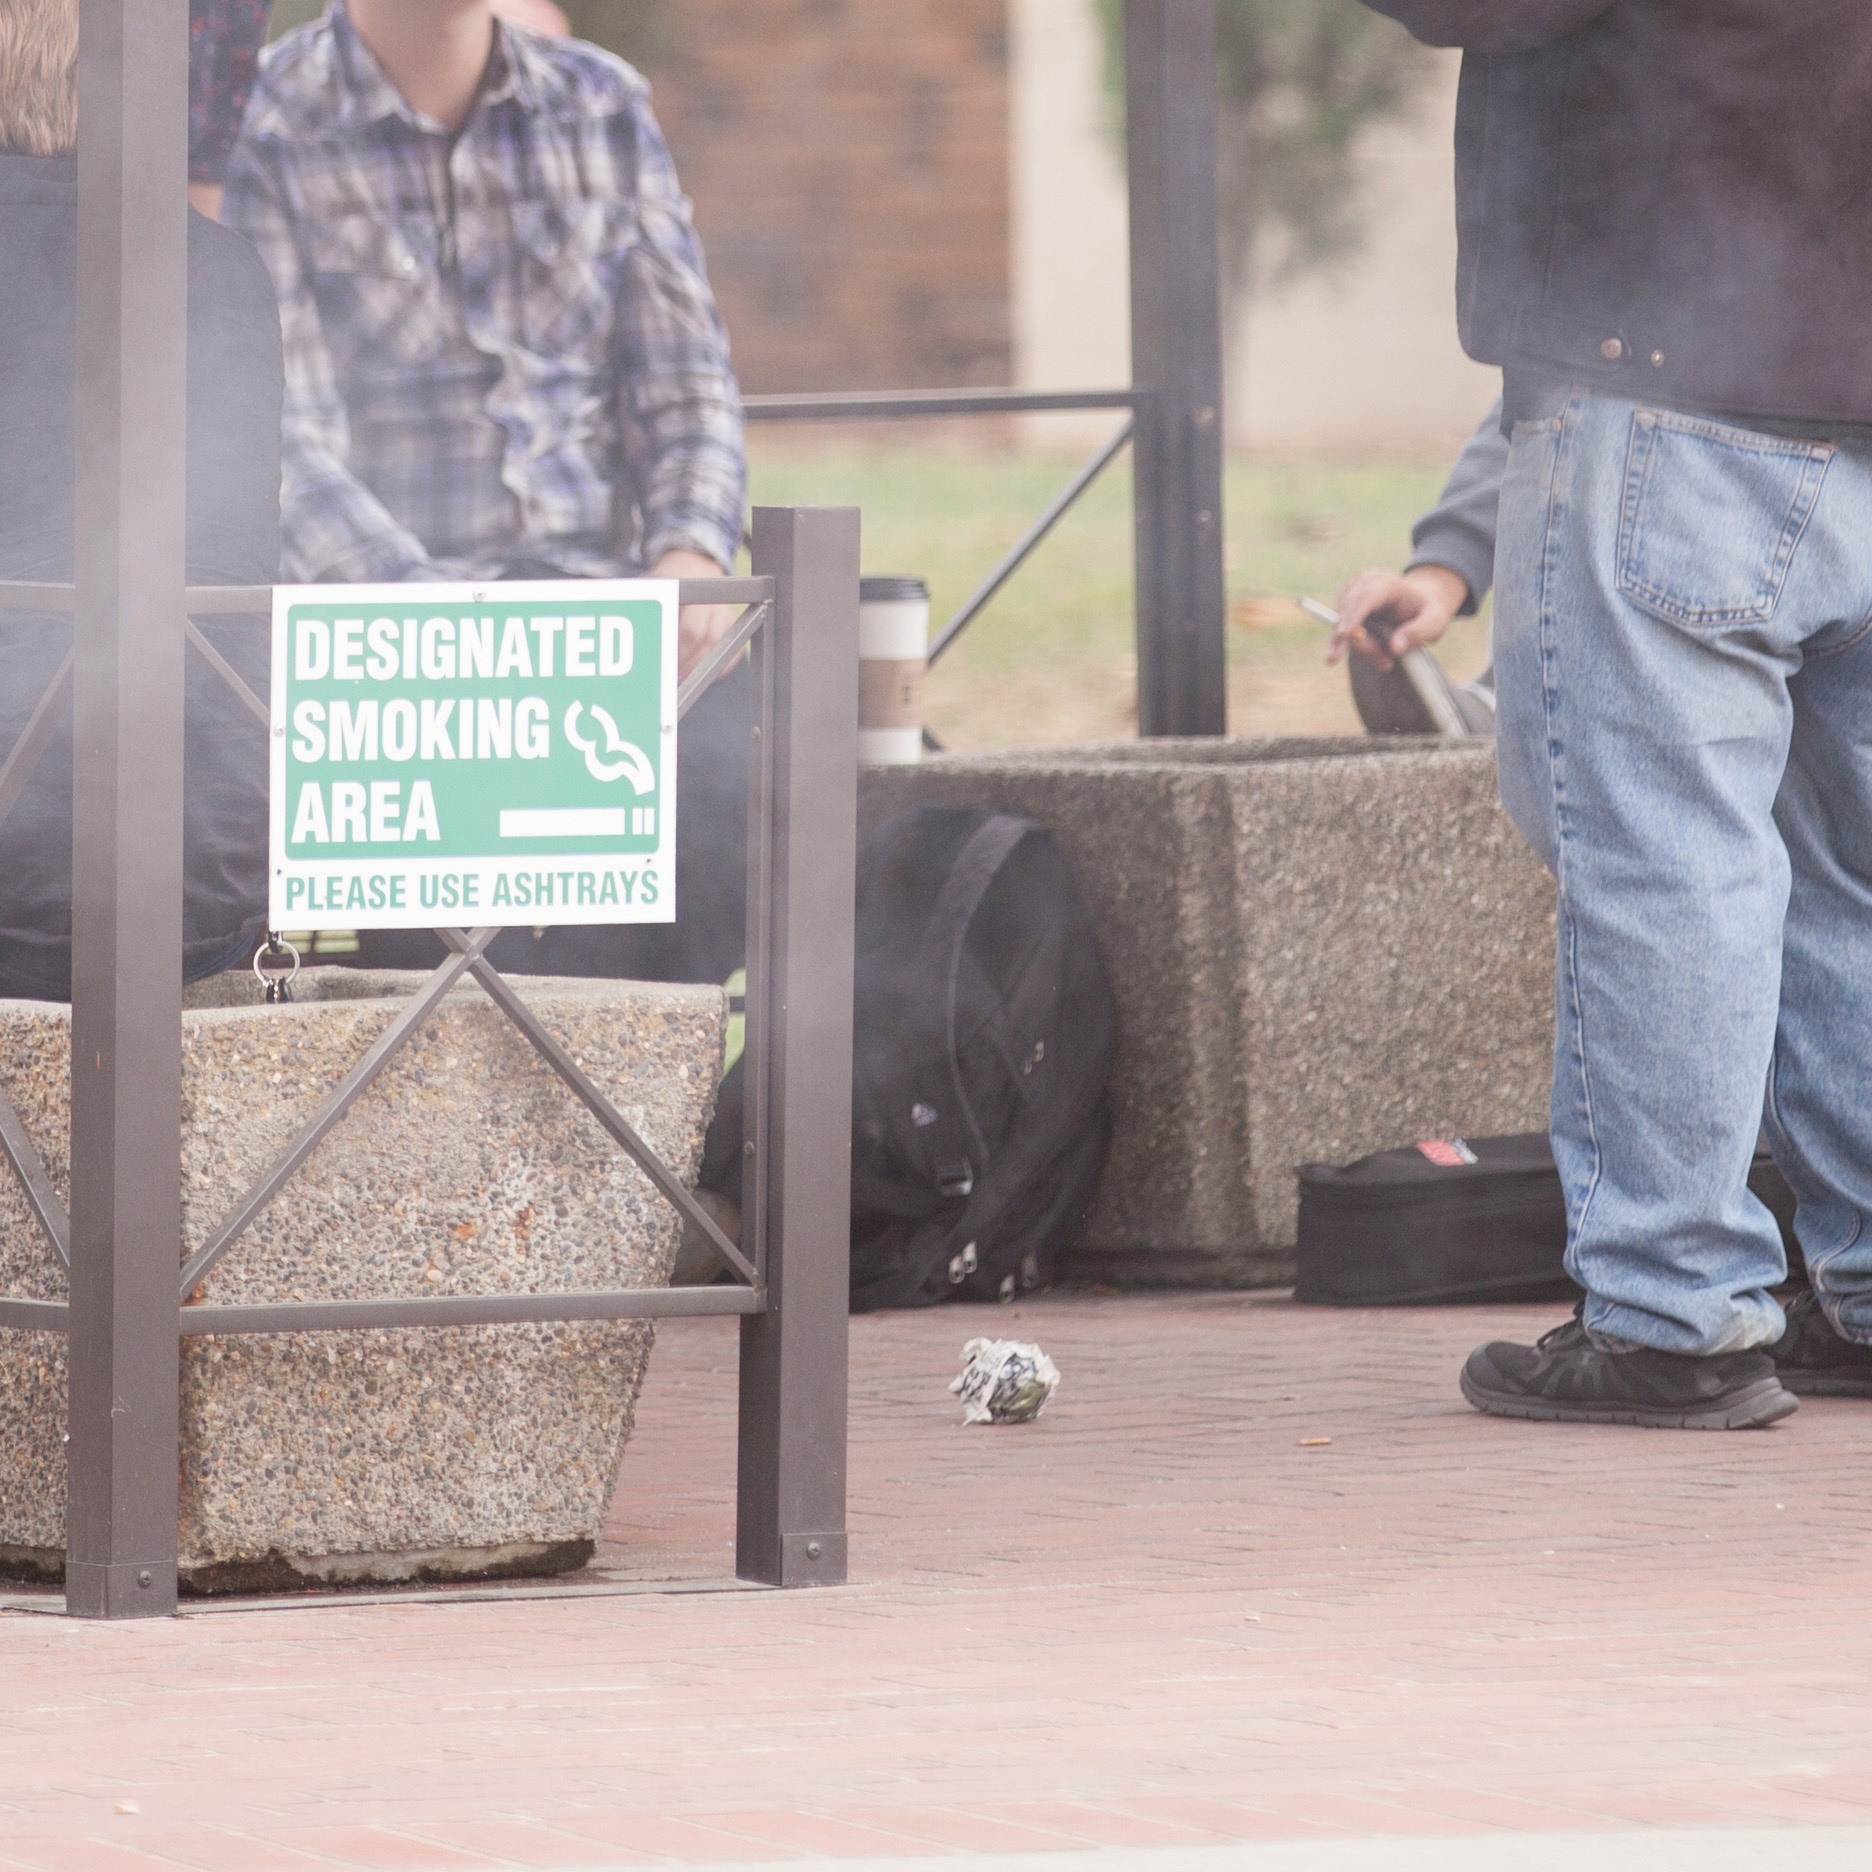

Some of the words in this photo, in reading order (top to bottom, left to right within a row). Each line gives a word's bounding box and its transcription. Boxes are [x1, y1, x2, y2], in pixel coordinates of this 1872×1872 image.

[295, 617, 633, 680] DESIGNATED
[293, 698, 550, 762] SMOKING
[291, 781, 440, 843] AREA
[286, 874, 407, 911] PLEASE
[419, 873, 480, 909] USE
[492, 870, 660, 907] ASHTRAYS
